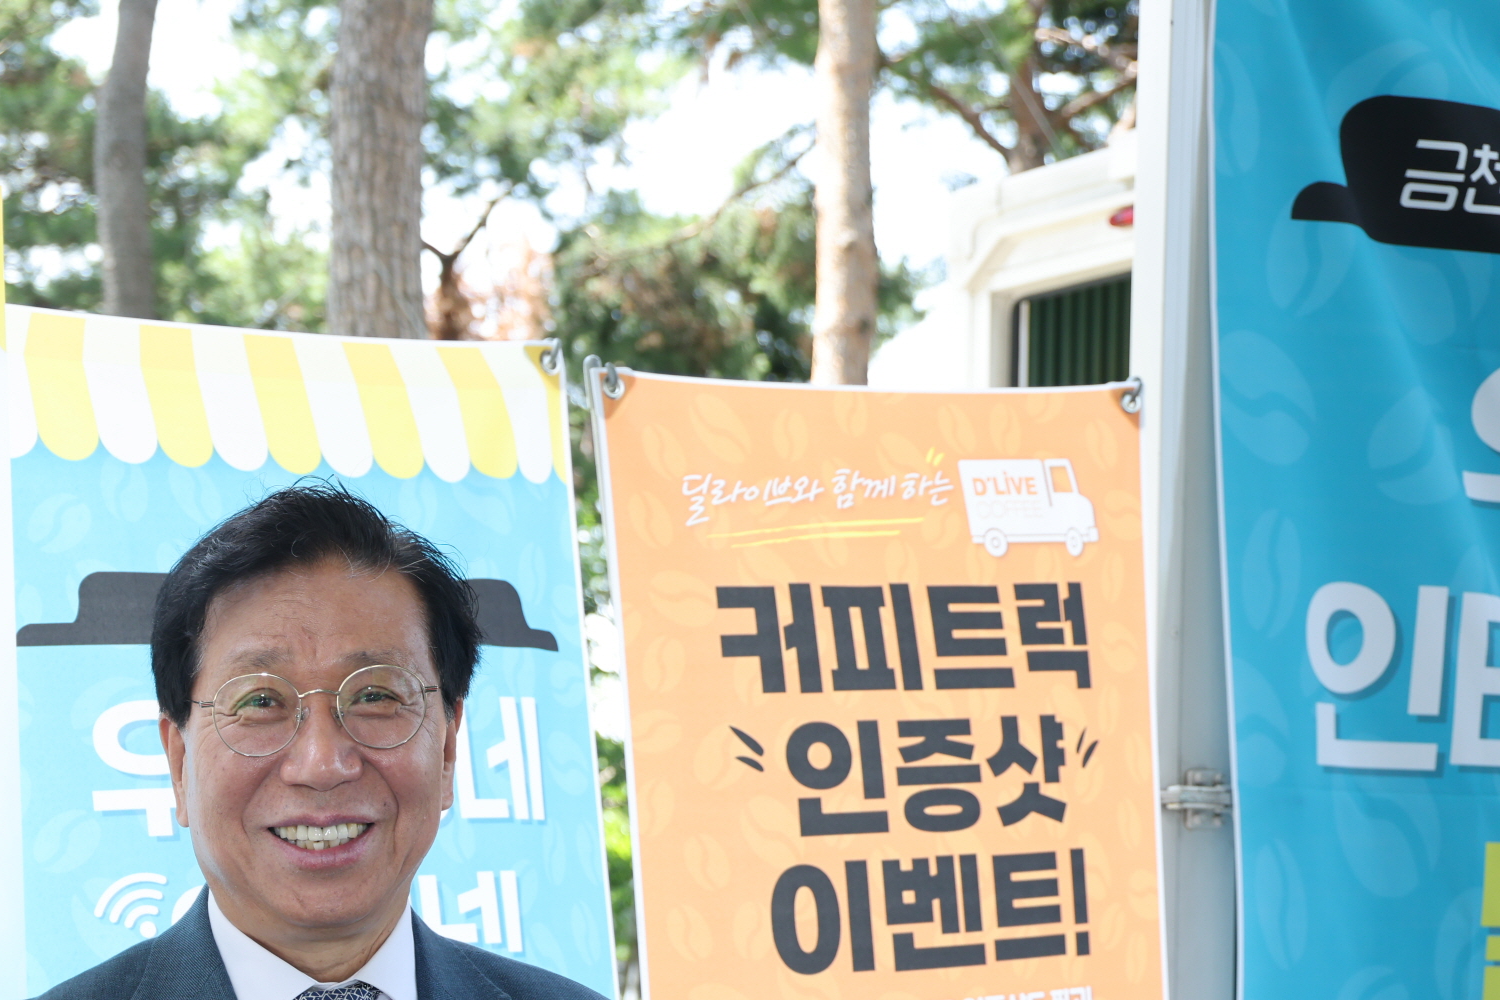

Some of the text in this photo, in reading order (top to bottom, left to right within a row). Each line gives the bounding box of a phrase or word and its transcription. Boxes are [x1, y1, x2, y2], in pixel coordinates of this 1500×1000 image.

[682, 468, 954, 527] 딜라이브와 함께 하는
[715, 581, 1092, 694] 커피트럭
[786, 714, 1067, 837] 인증샷
[770, 848, 1091, 976] 이벤트!
